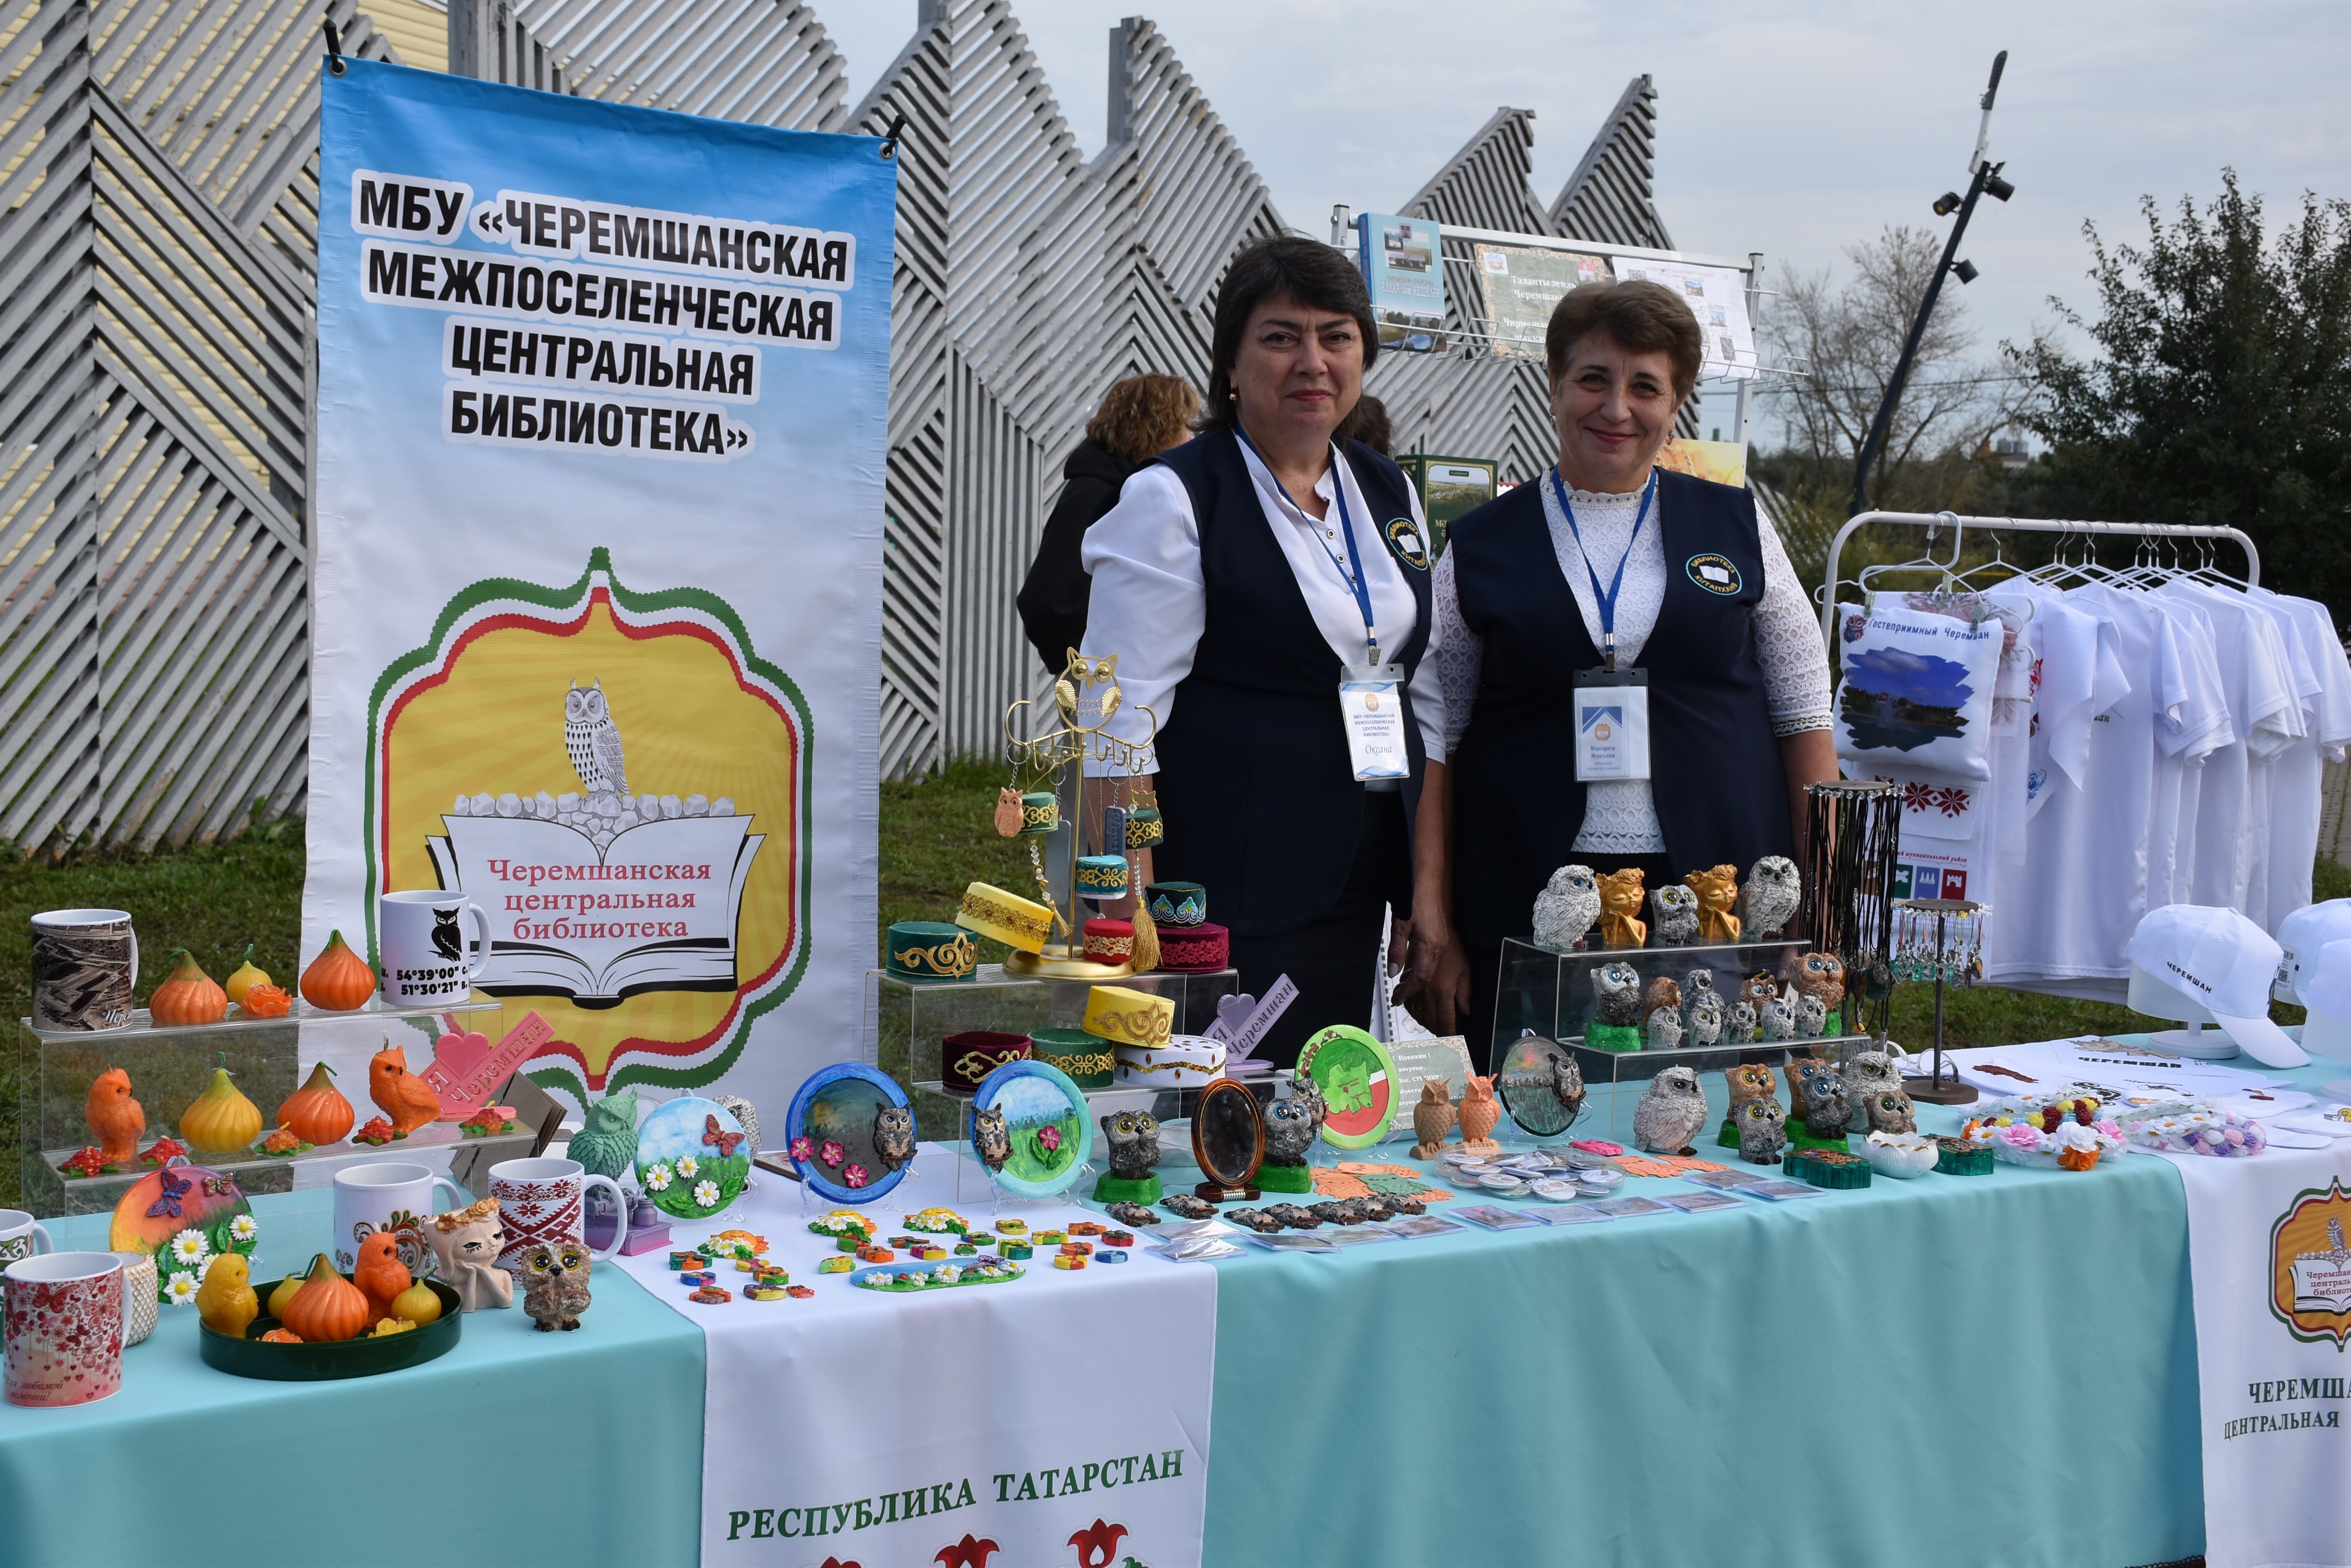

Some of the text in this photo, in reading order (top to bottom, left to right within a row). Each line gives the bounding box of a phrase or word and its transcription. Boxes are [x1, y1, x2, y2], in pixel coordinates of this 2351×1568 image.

[360, 179, 848, 282] МБУ «ЧЕРЕМШАНСКАЯ
[1511, 275, 1550, 287] Таланты
[369, 249, 834, 342] МЕЖПОСЕЛЕНЧЕСКАЯ
[451, 325, 754, 396] ЦЕНТРАЛЬНАЯ
[451, 390, 748, 455] БИБЛИОТЕКА»
[1390, 521, 1418, 540] БИБЛИОТЕКА
[1691, 556, 1736, 573] БИБЛИОТЕКА
[1695, 575, 1738, 592] КИТАПХАНӘ
[1869, 618, 1938, 636] Гостеприимный
[1365, 745, 1392, 756] Оксана
[1905, 852, 1949, 861] муниципальный
[487, 859, 712, 887] Черемшанская
[504, 890, 696, 916] центральная
[513, 917, 688, 940] библиотека
[2167, 961, 2212, 994] ЧЕРЕМШАН
[1227, 983, 1293, 1055] Черемшан
[1213, 1027, 1229, 1042] Я
[448, 1019, 546, 1103] Черемшан
[2078, 1057, 2182, 1068] ЧЕРЕМШАН
[428, 1069, 451, 1093] Я
[2306, 1269, 2351, 1280] Черемшан
[10, 1391, 51, 1401] мамочки!
[20, 1379, 64, 1390] любимой
[2224, 1410, 2340, 1442] ЦЕНТРАЛЬНАЯ
[727, 1449, 1185, 1541] РЕСПУБЛИКА ТАТАРСТАН
